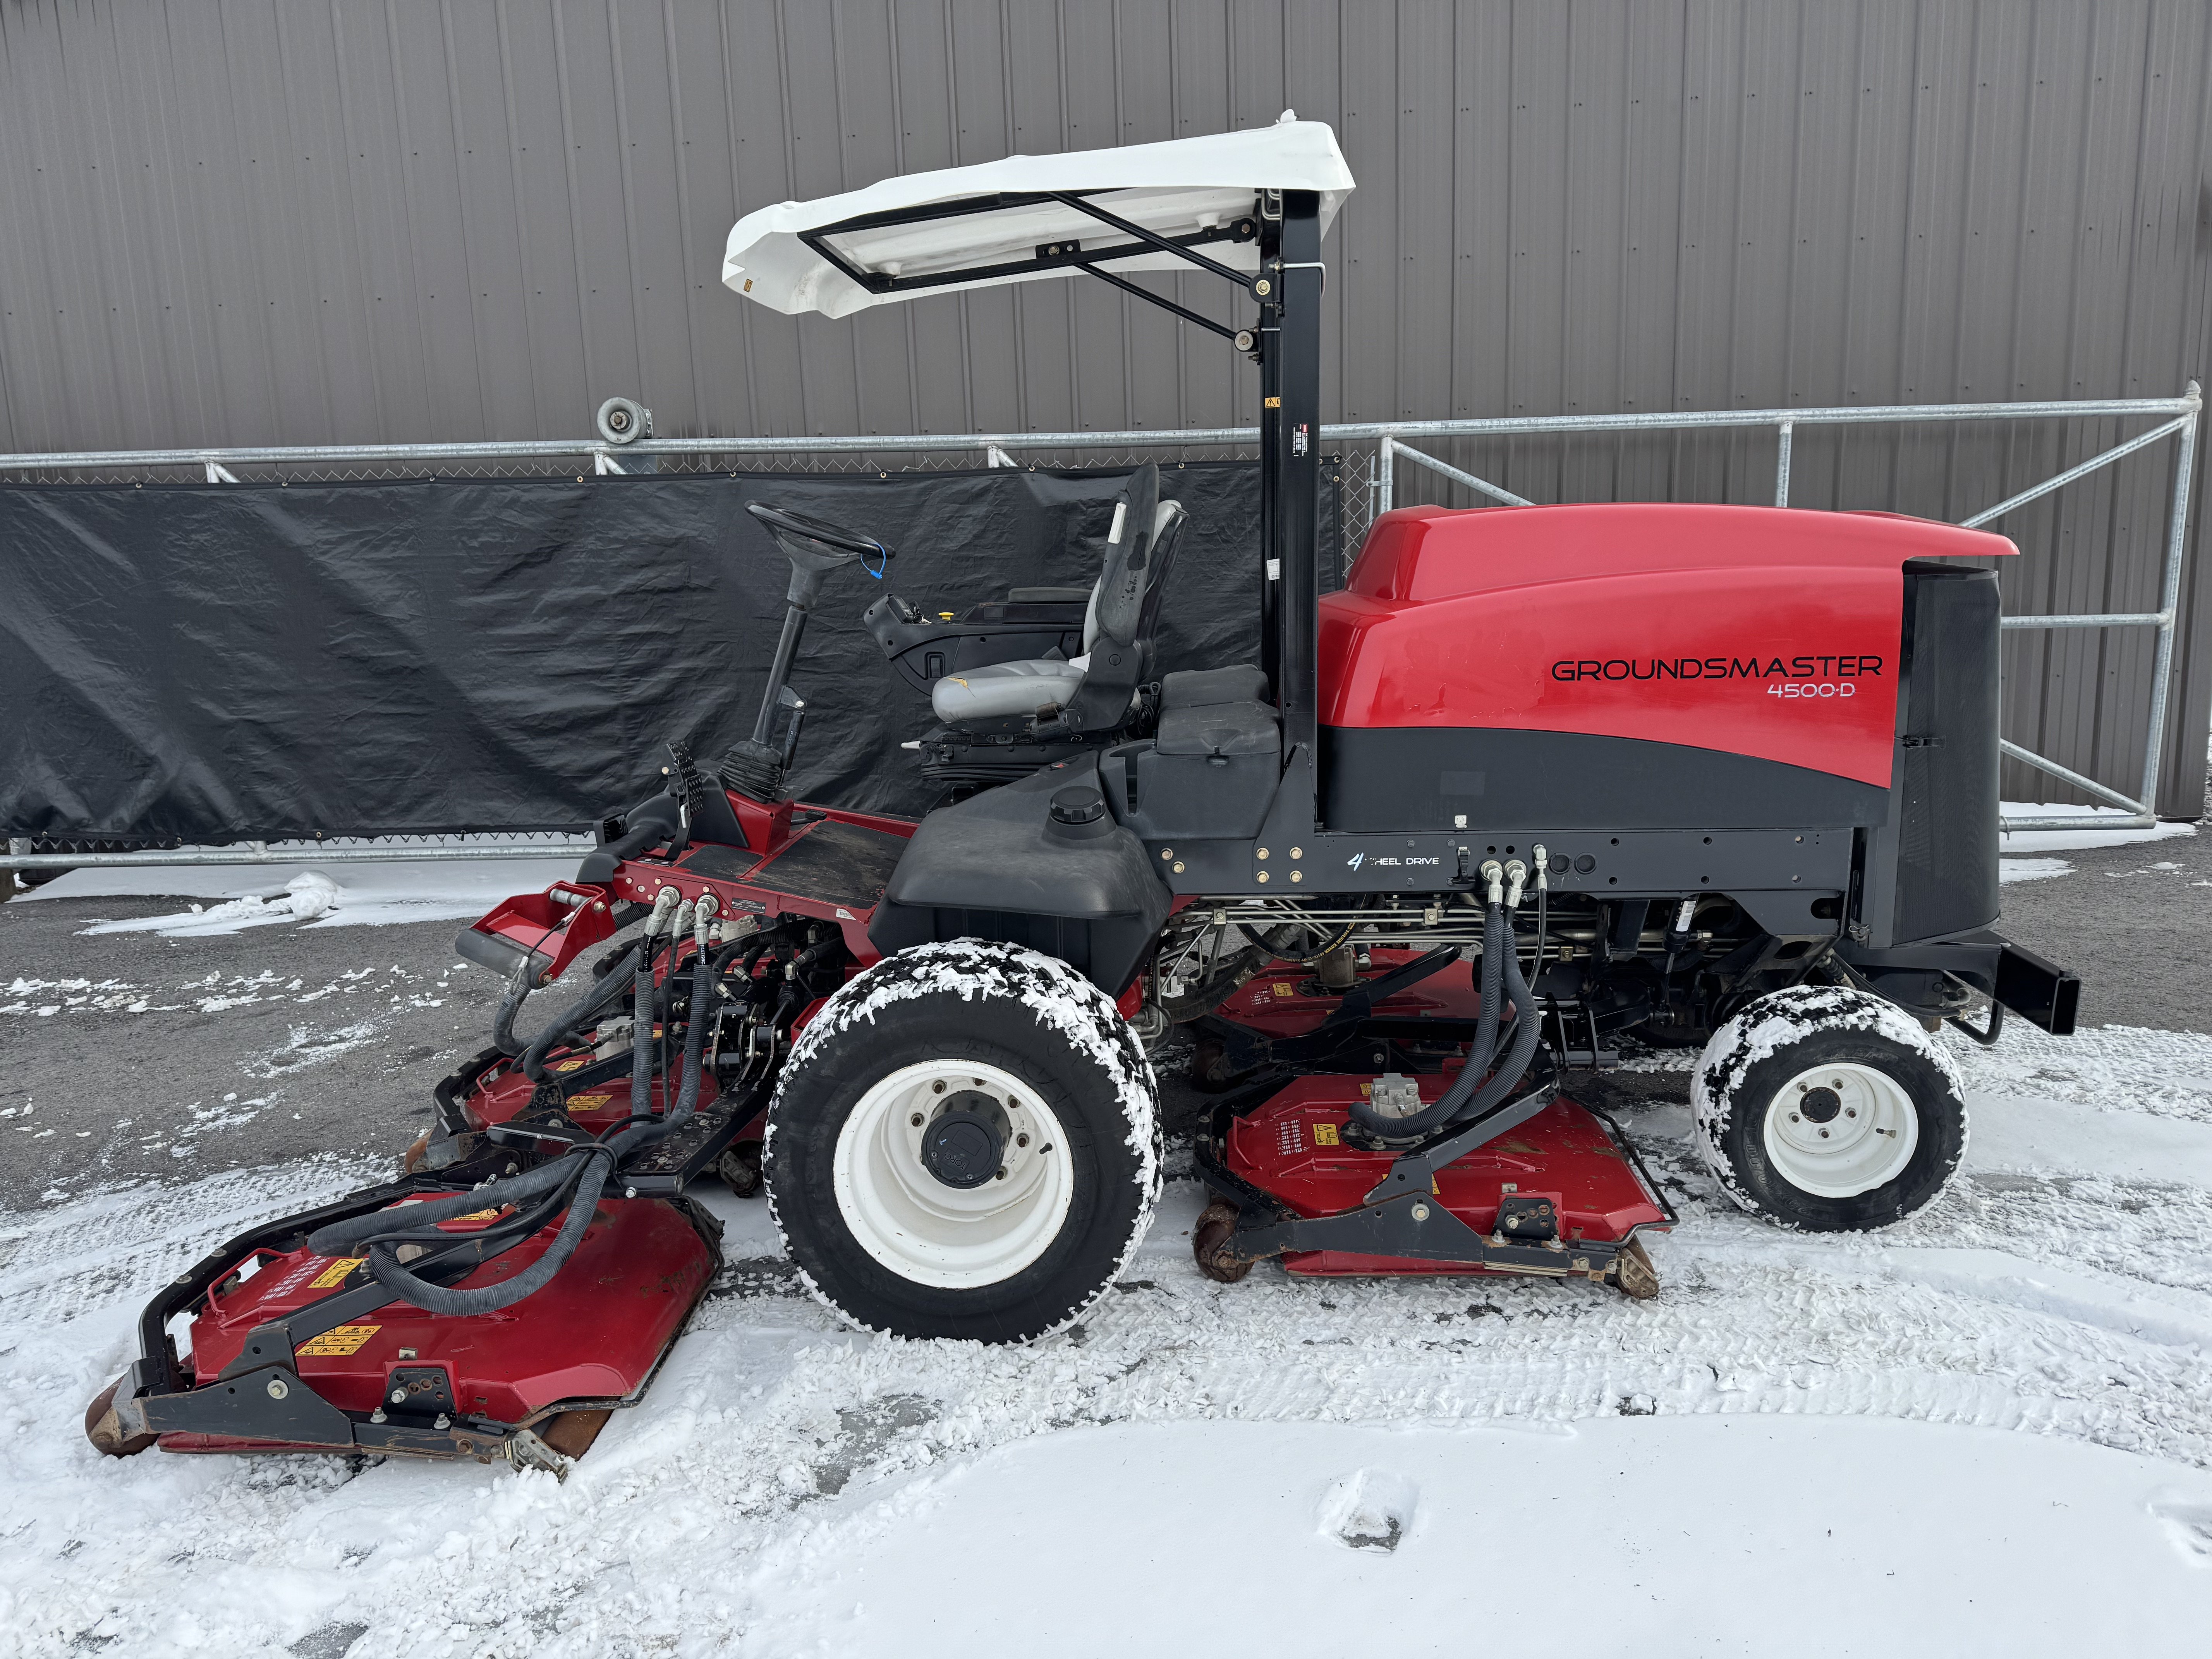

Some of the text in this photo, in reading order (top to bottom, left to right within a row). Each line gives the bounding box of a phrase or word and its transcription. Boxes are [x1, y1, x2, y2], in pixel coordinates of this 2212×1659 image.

[1551, 655, 1883, 681] GROUNDSMASTER
[1347, 852, 1364, 871] 4
[944, 1153, 966, 1170] TORO
